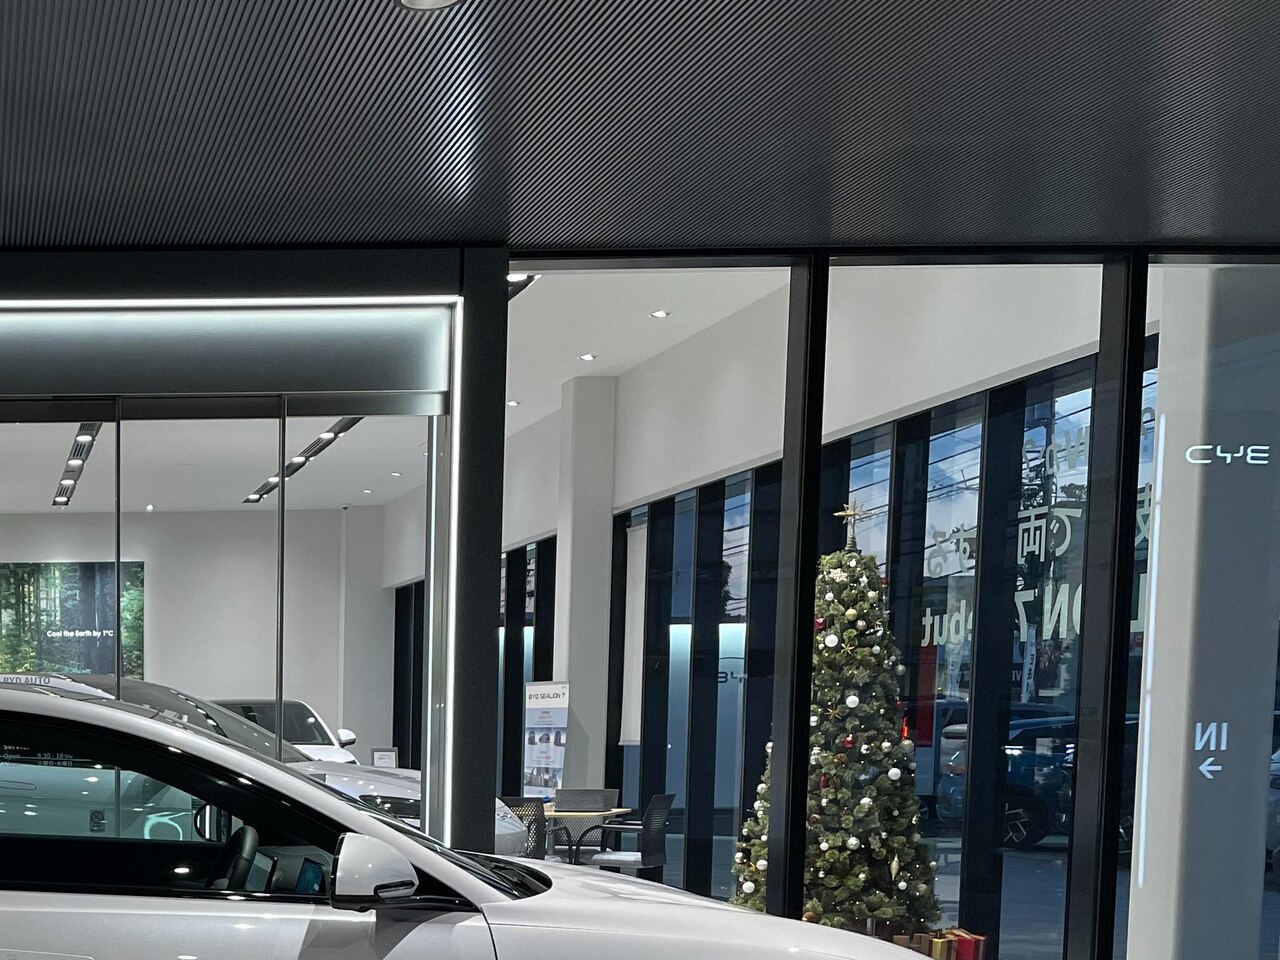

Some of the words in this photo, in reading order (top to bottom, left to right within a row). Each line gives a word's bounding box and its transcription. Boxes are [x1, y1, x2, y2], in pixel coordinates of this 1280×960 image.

[46, 630, 62, 638] Cool
[63, 630, 74, 638] the
[93, 630, 101, 638] by
[24, 676, 51, 685] AUTO
